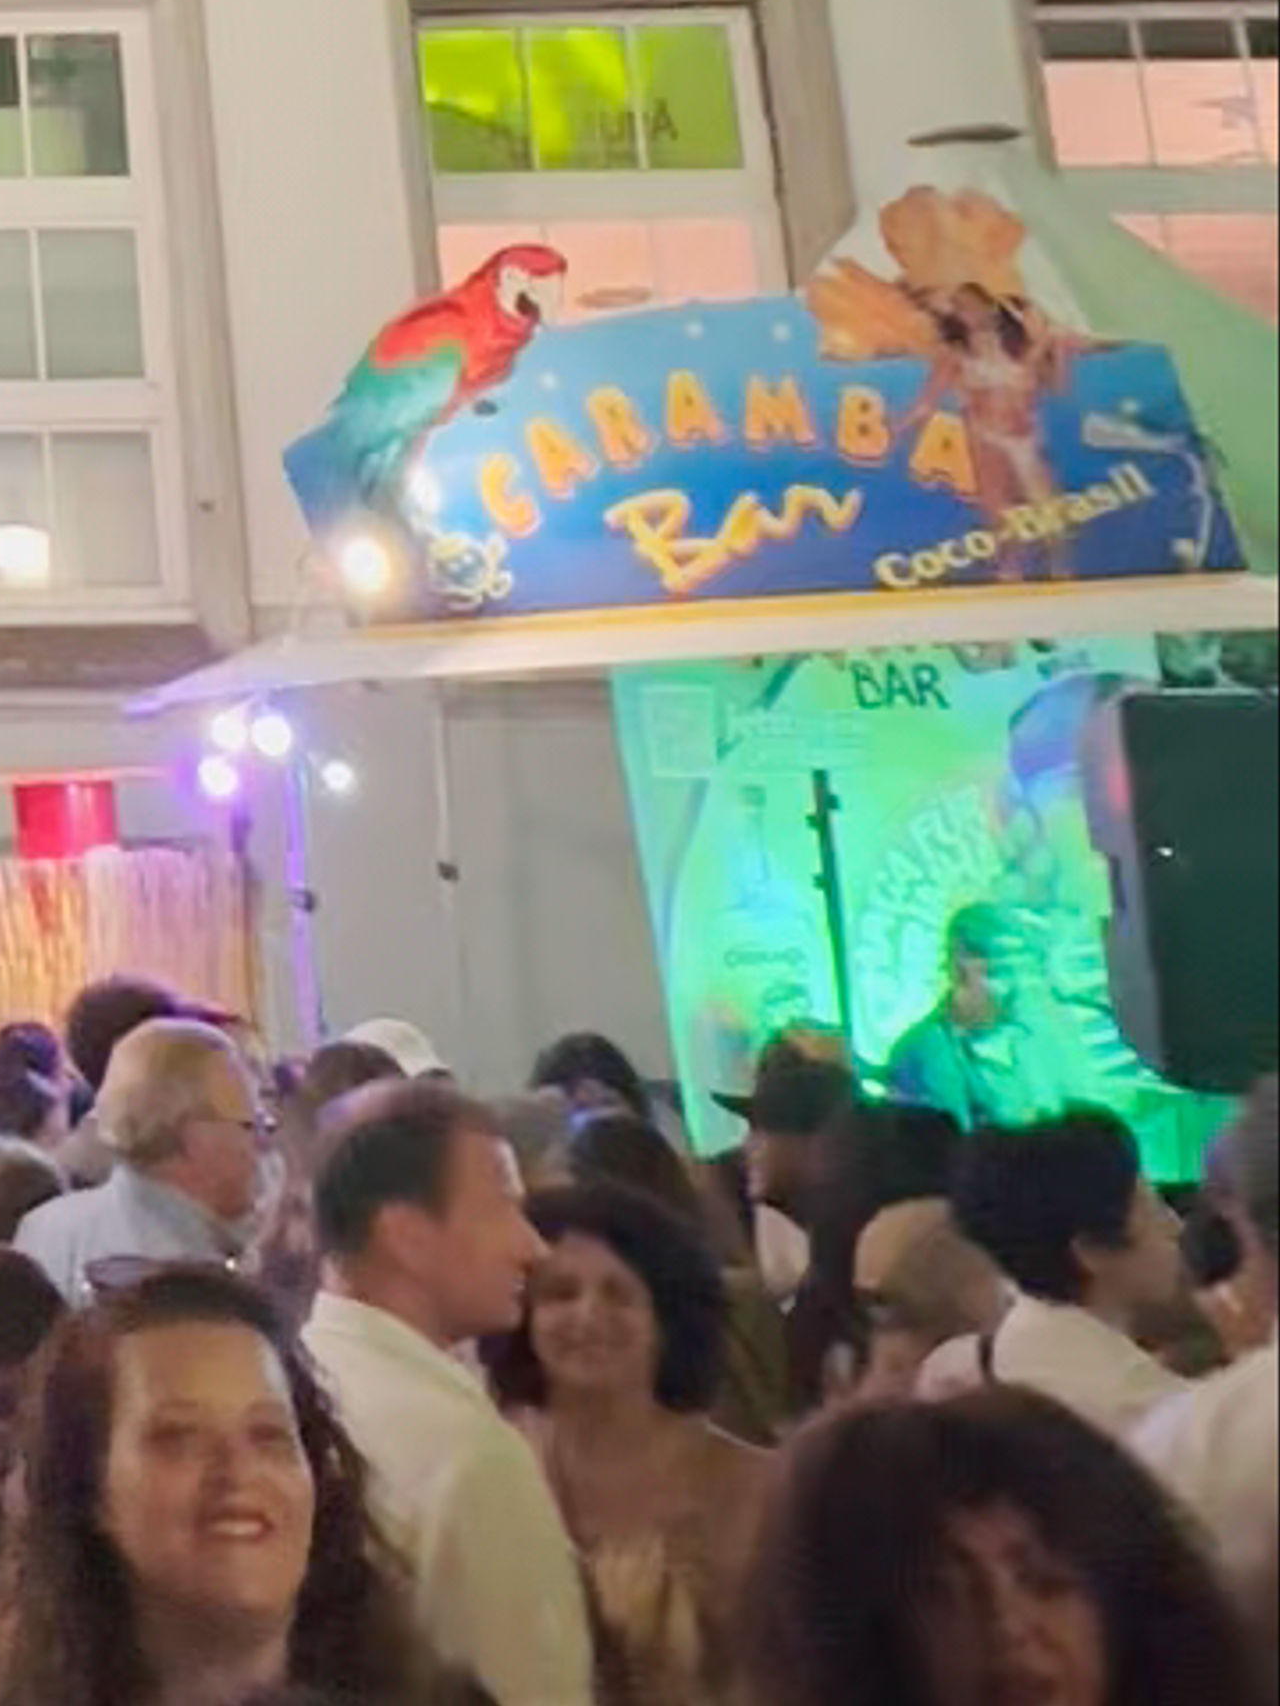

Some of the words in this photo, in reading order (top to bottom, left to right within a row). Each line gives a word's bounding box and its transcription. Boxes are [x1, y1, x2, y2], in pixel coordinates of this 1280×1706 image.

[479, 369, 981, 538] CARAMBA
[602, 483, 863, 596] Bar
[850, 660, 950, 710] BAR
